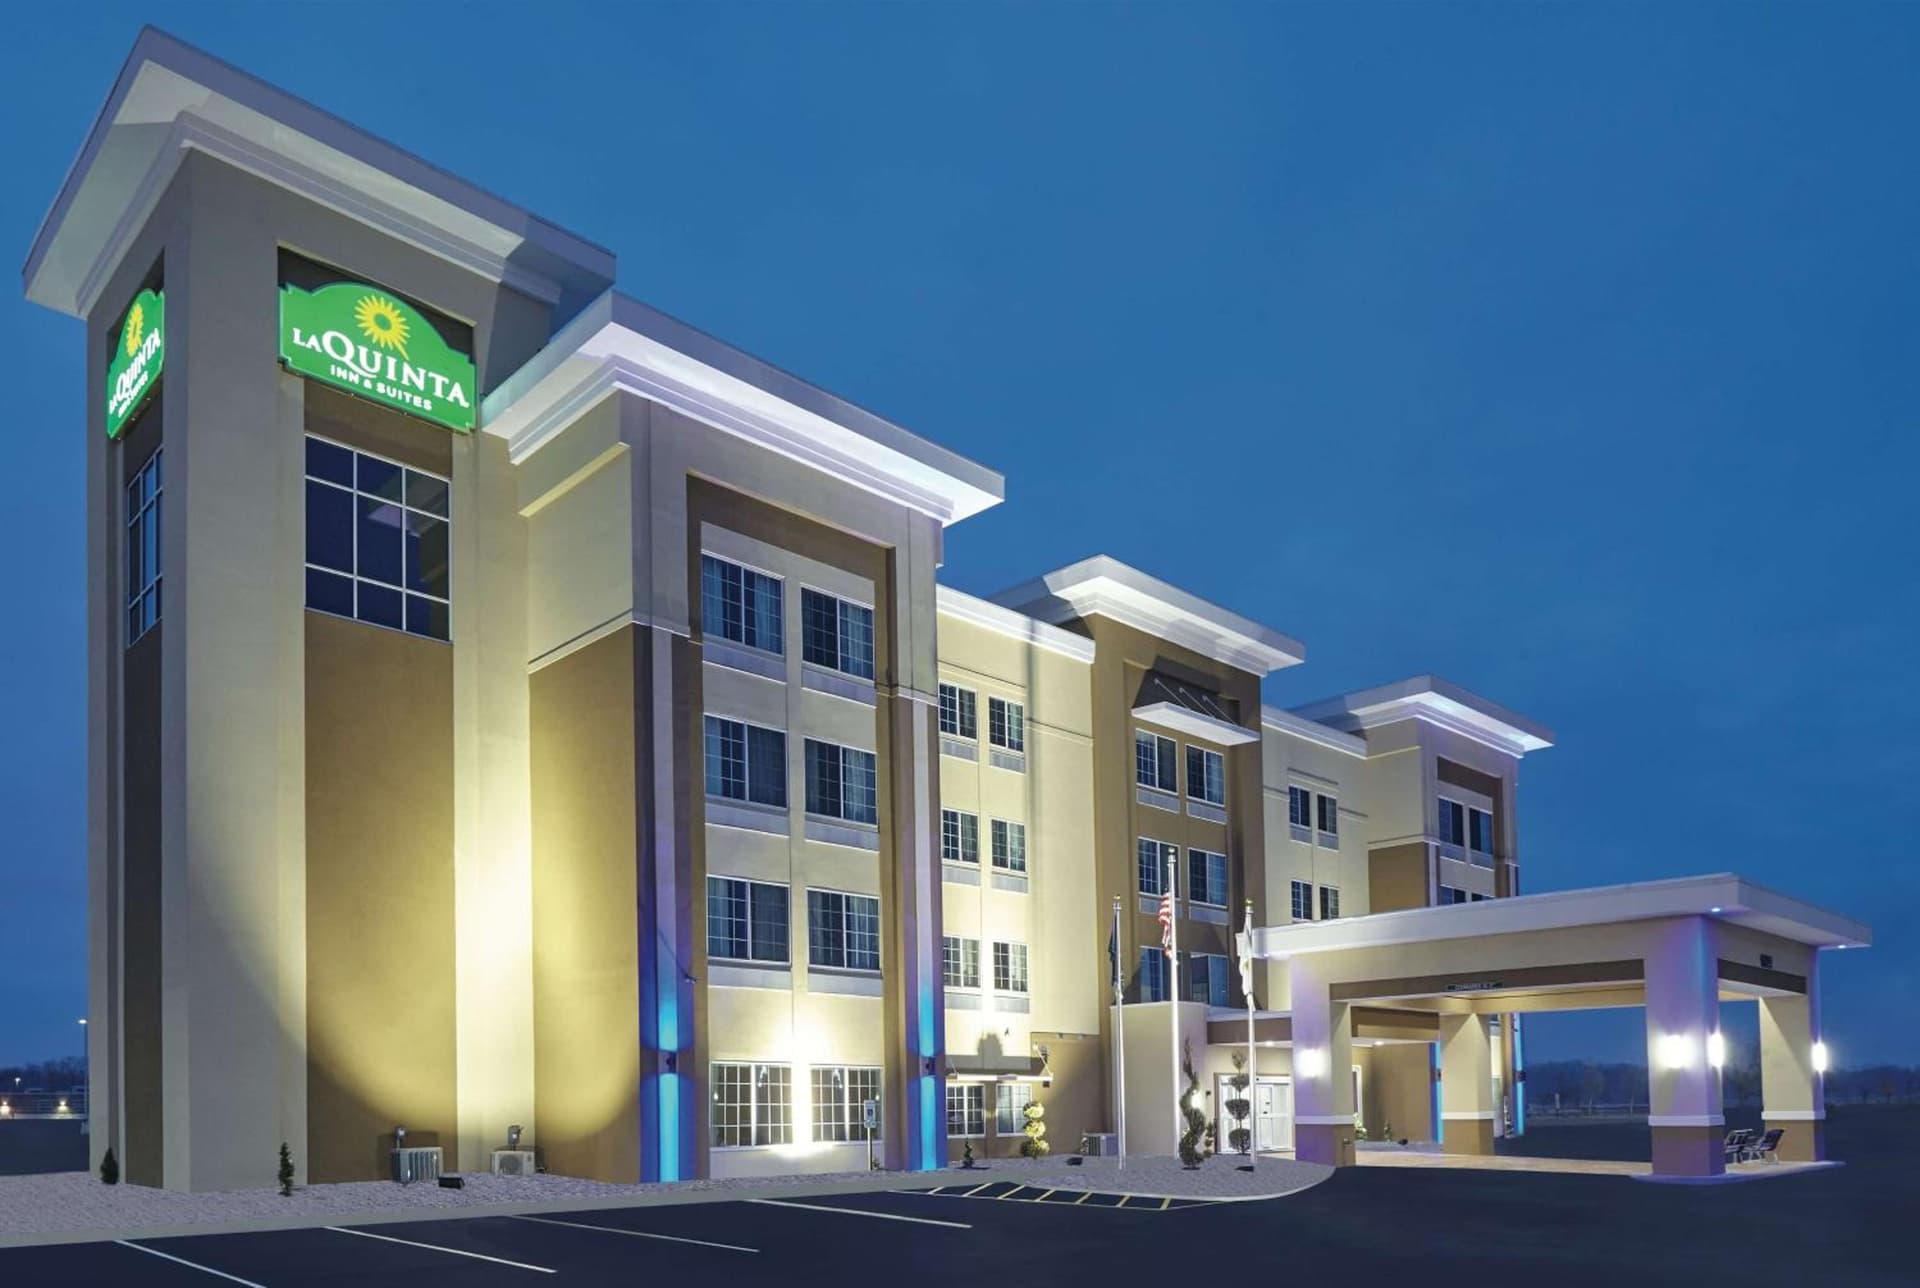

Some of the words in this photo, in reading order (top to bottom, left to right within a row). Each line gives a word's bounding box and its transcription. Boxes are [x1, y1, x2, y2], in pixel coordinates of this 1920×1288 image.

[322, 331, 470, 408] QUINTA
[330, 365, 359, 385] INN
[363, 377, 372, 389] &
[376, 382, 432, 410] SUITES
